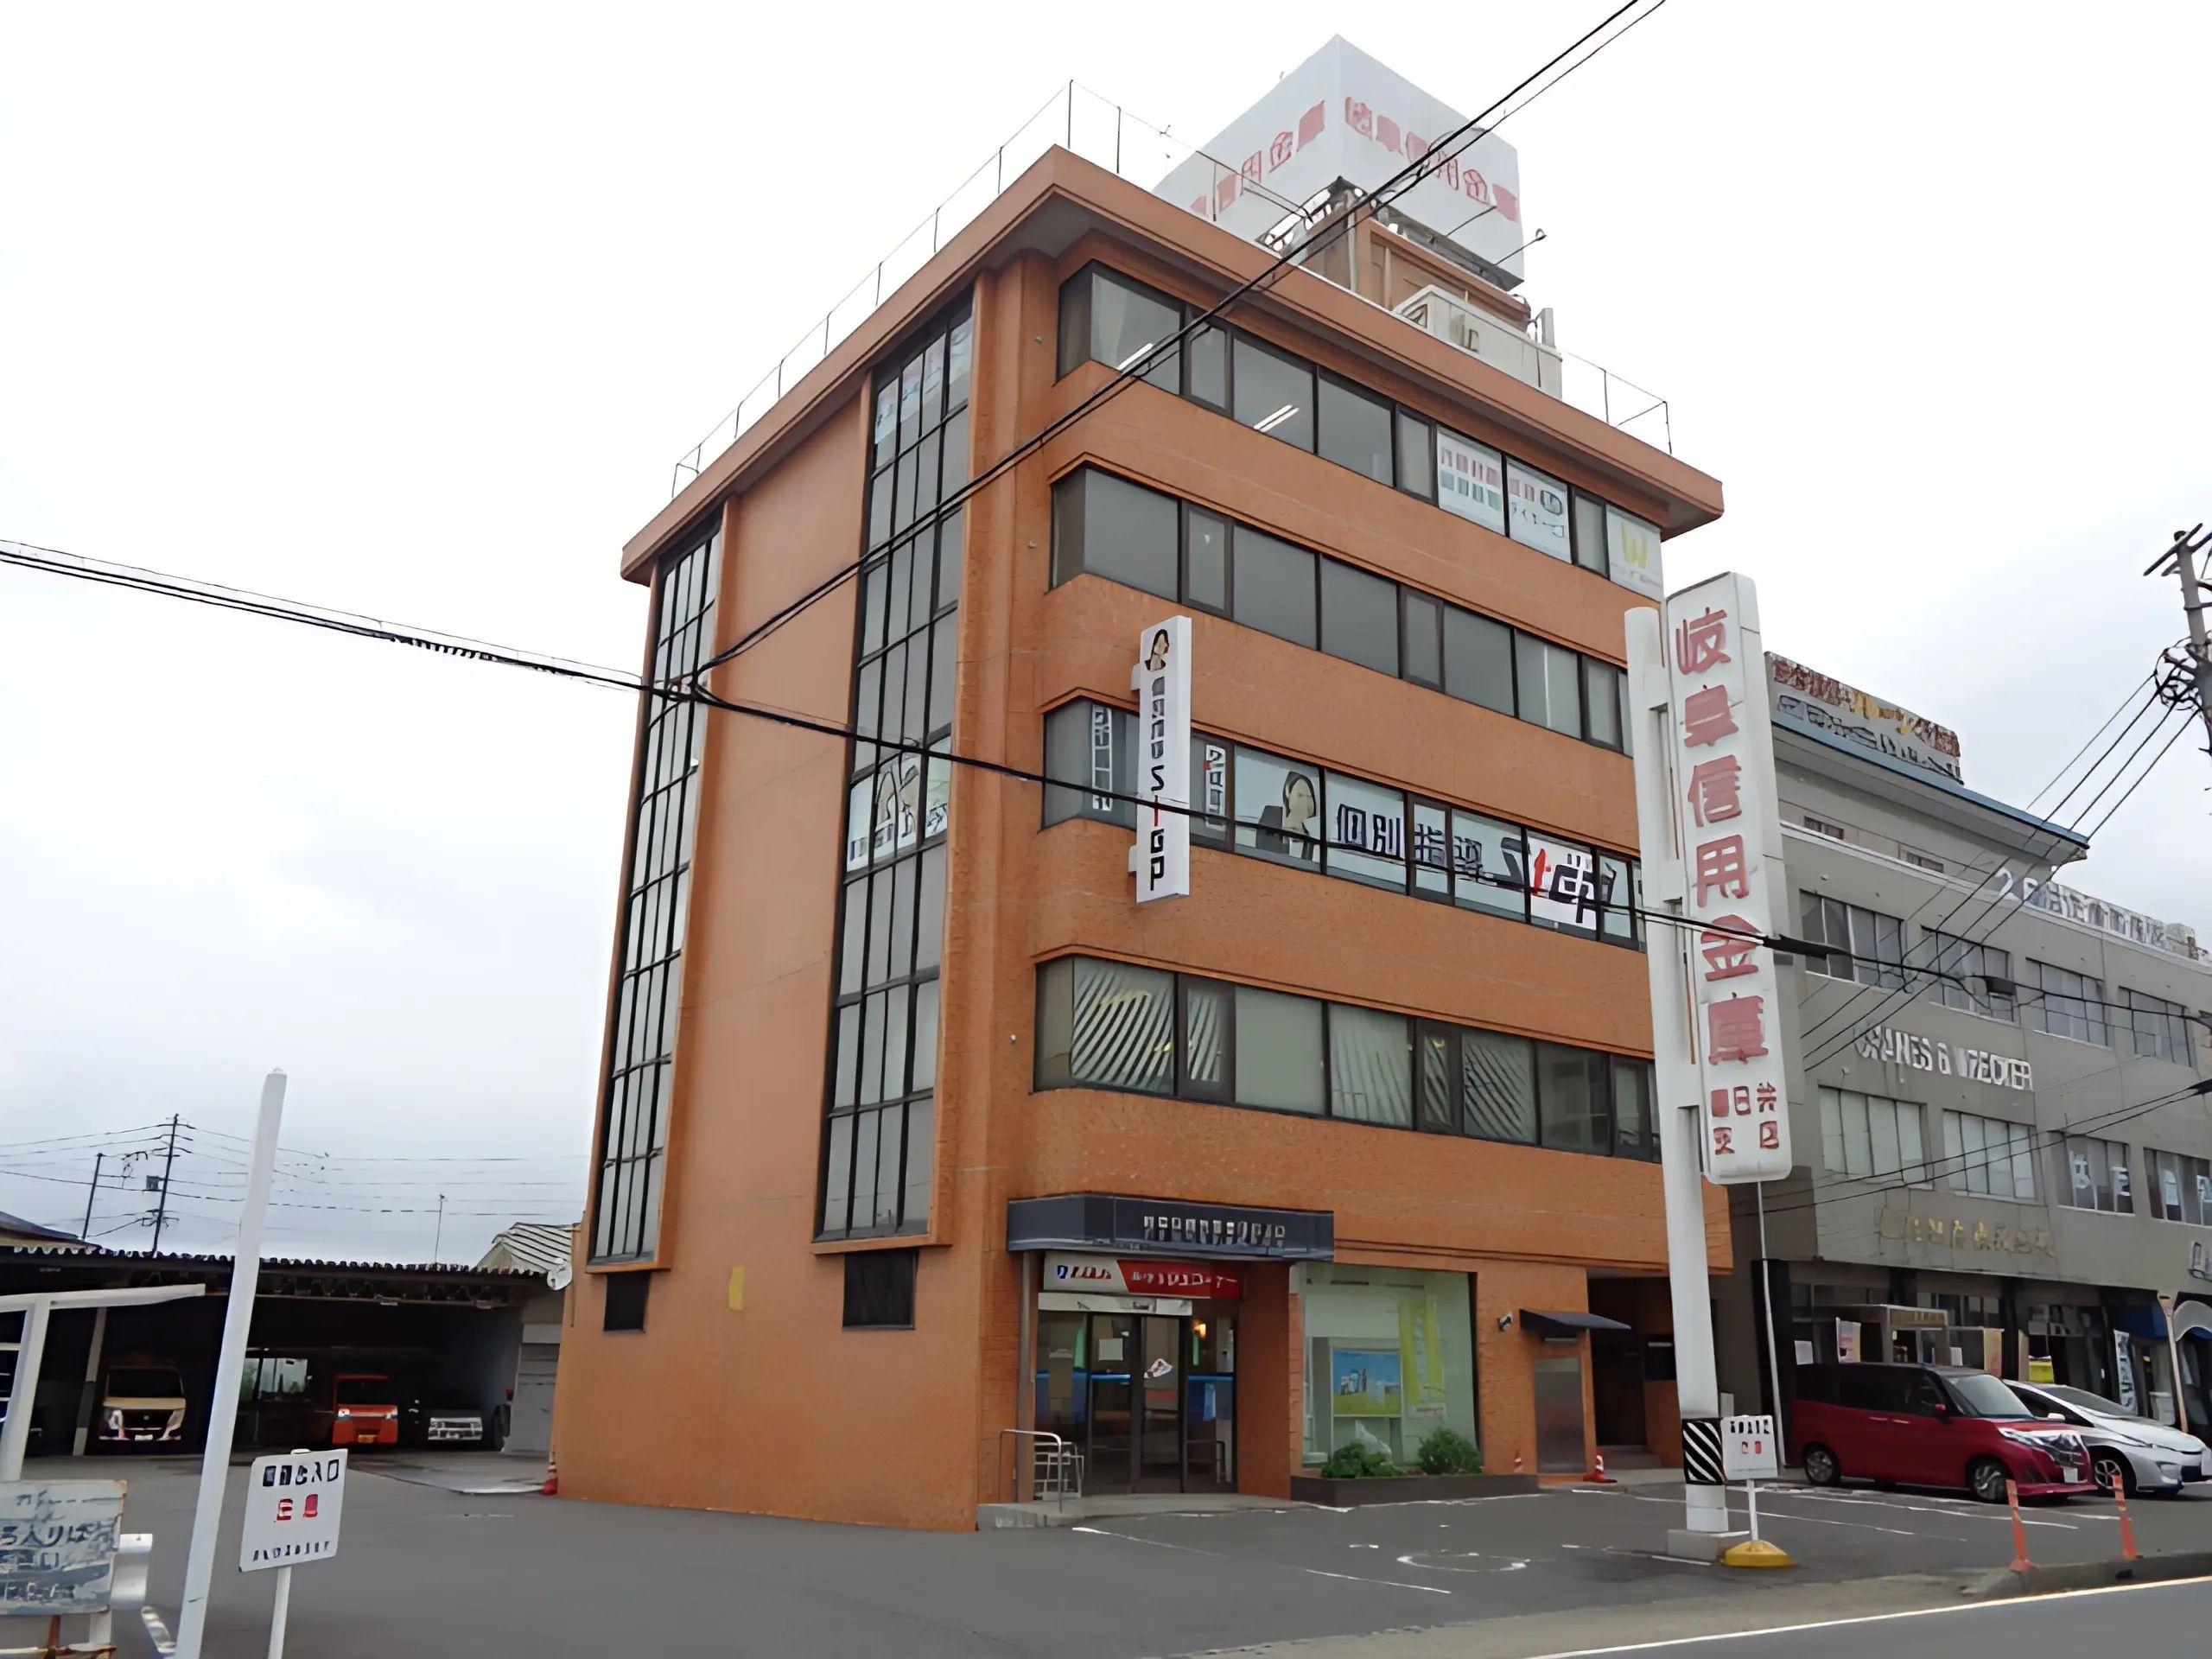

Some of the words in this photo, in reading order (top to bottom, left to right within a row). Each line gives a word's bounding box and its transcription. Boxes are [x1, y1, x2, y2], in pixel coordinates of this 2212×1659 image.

[1675, 607, 1770, 1066] 岐阜信用金庫
